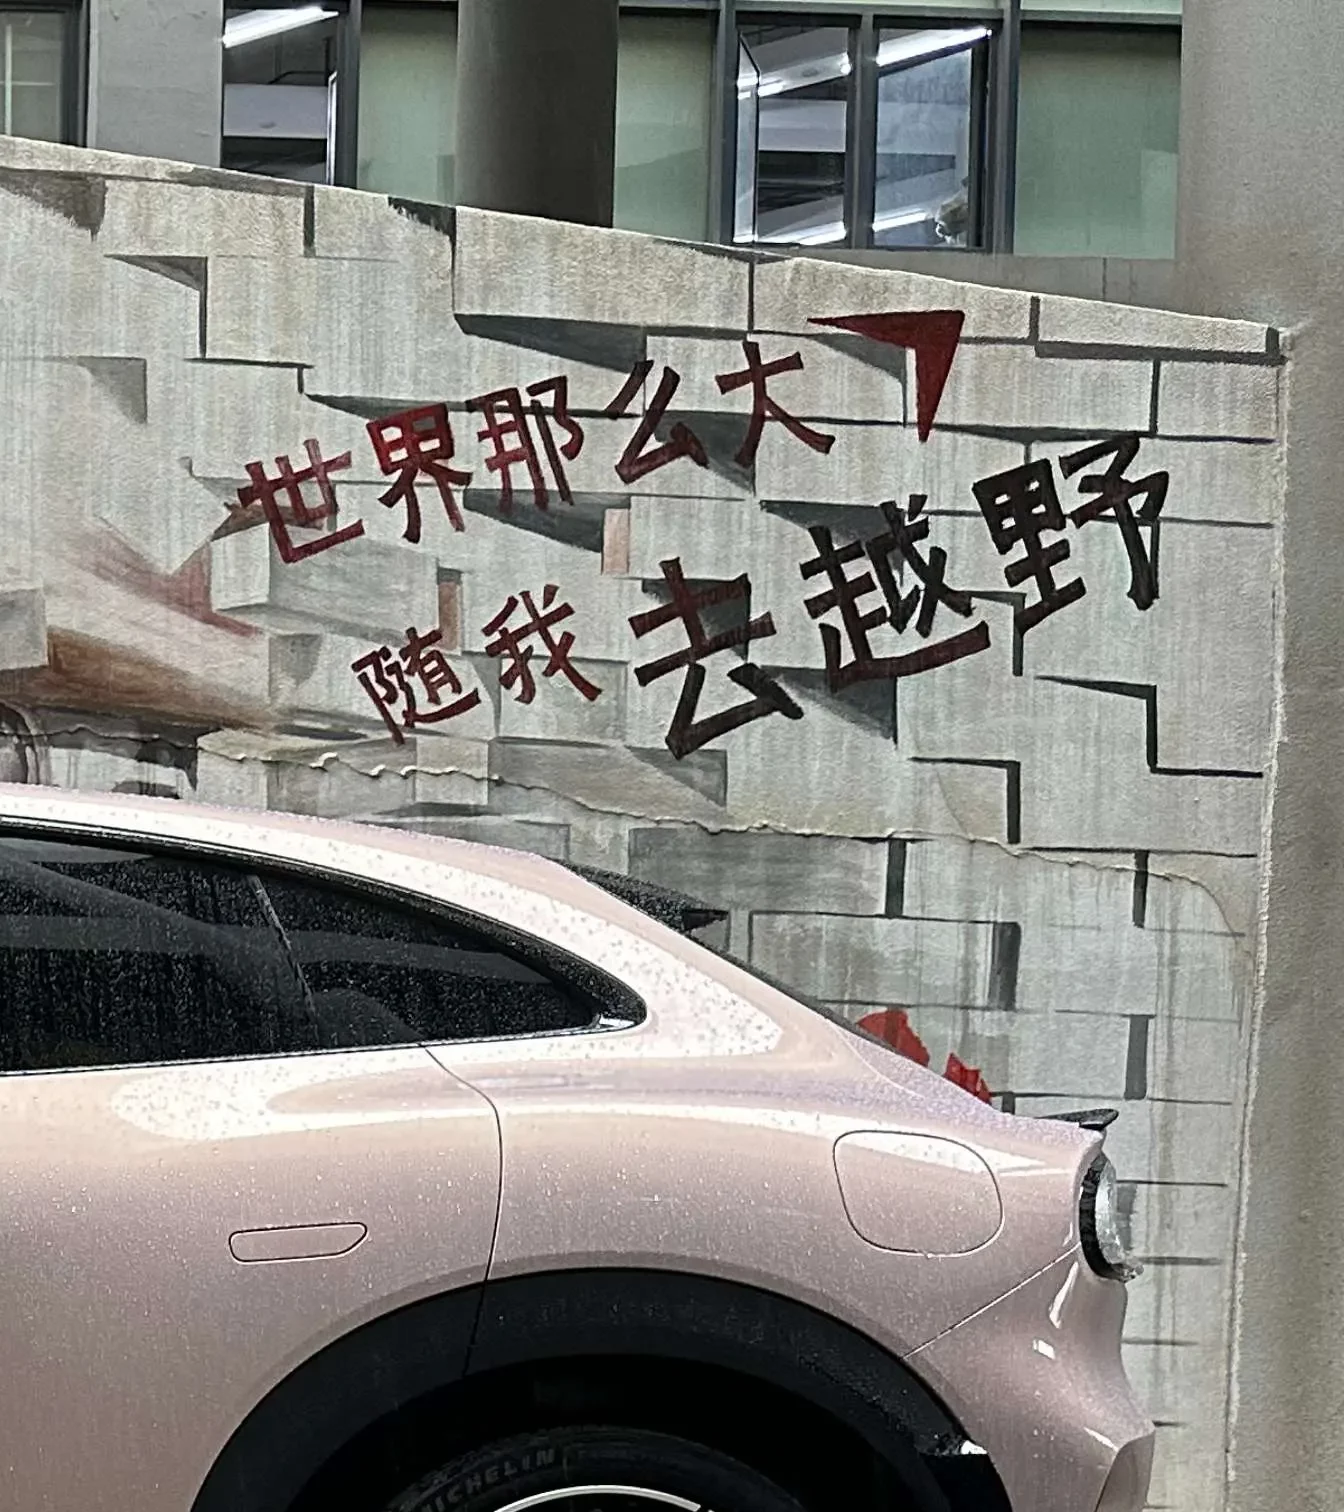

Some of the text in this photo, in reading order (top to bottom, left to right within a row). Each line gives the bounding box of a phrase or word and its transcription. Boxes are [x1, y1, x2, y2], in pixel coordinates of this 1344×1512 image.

[236, 339, 835, 564] 世界那么大
[352, 436, 1170, 759] 随我去越野
